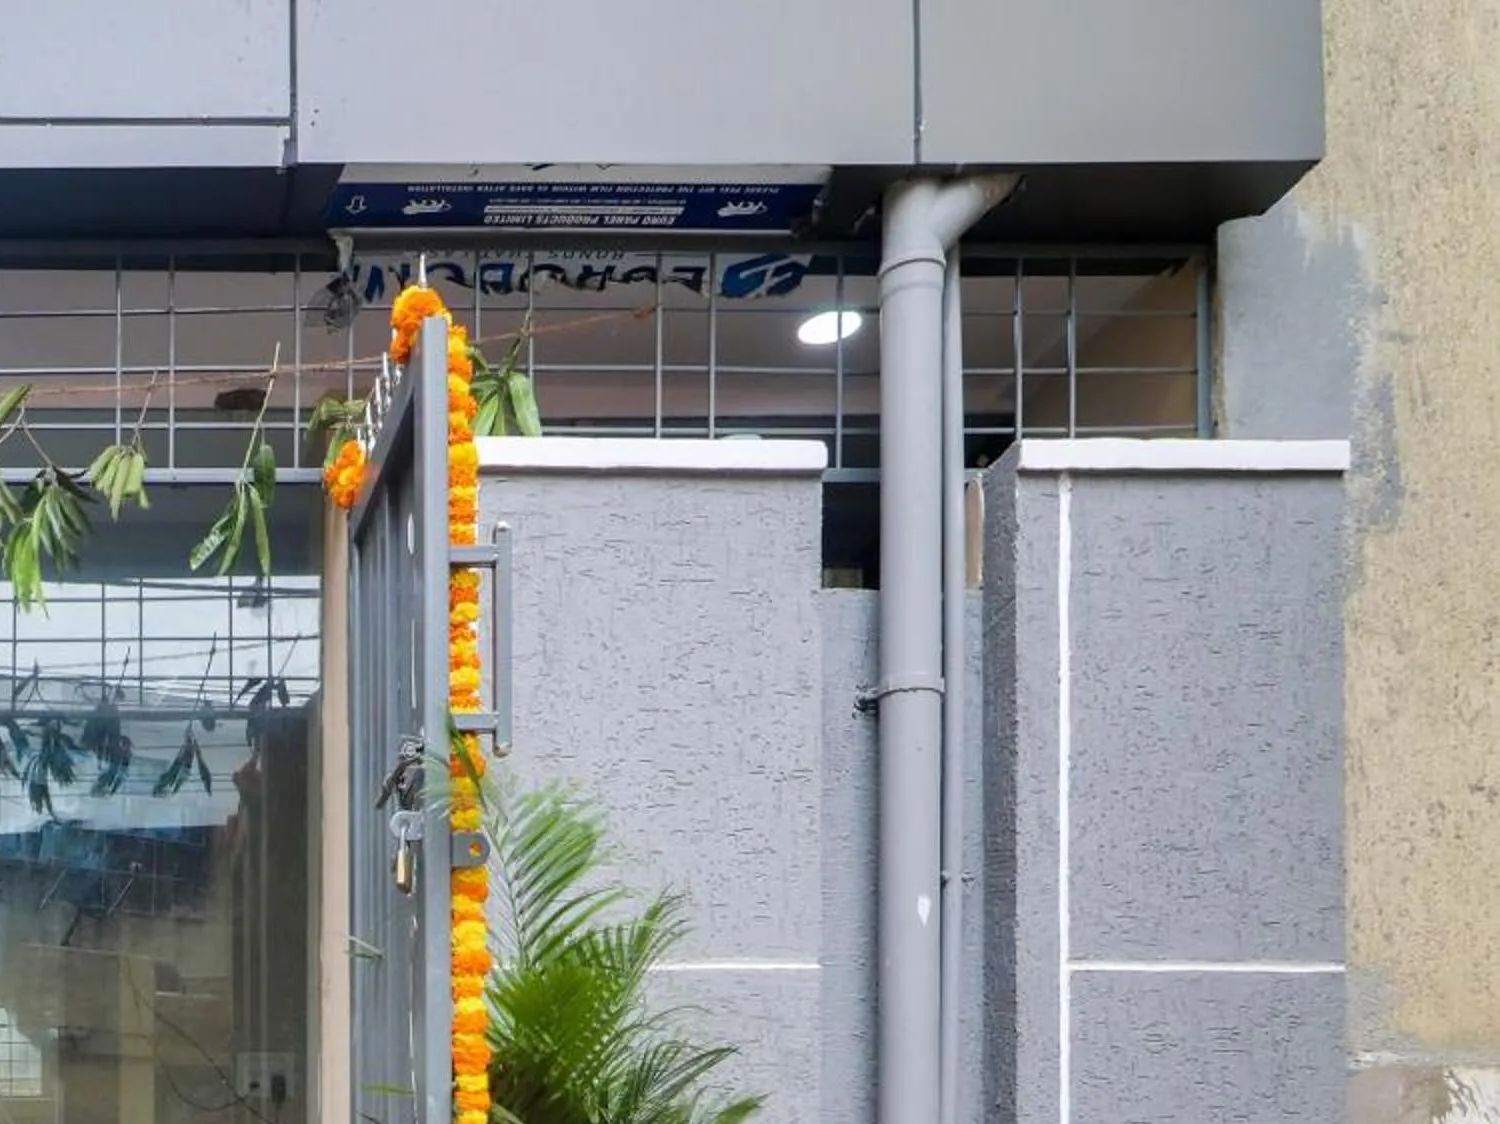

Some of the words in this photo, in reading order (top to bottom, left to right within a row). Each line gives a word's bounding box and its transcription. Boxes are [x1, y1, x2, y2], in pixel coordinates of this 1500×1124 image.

[483, 214, 533, 225] LIMITED
[535, 214, 600, 225] PRODUCTS
[603, 215, 641, 225] PANEL
[644, 215, 676, 225] EURO
